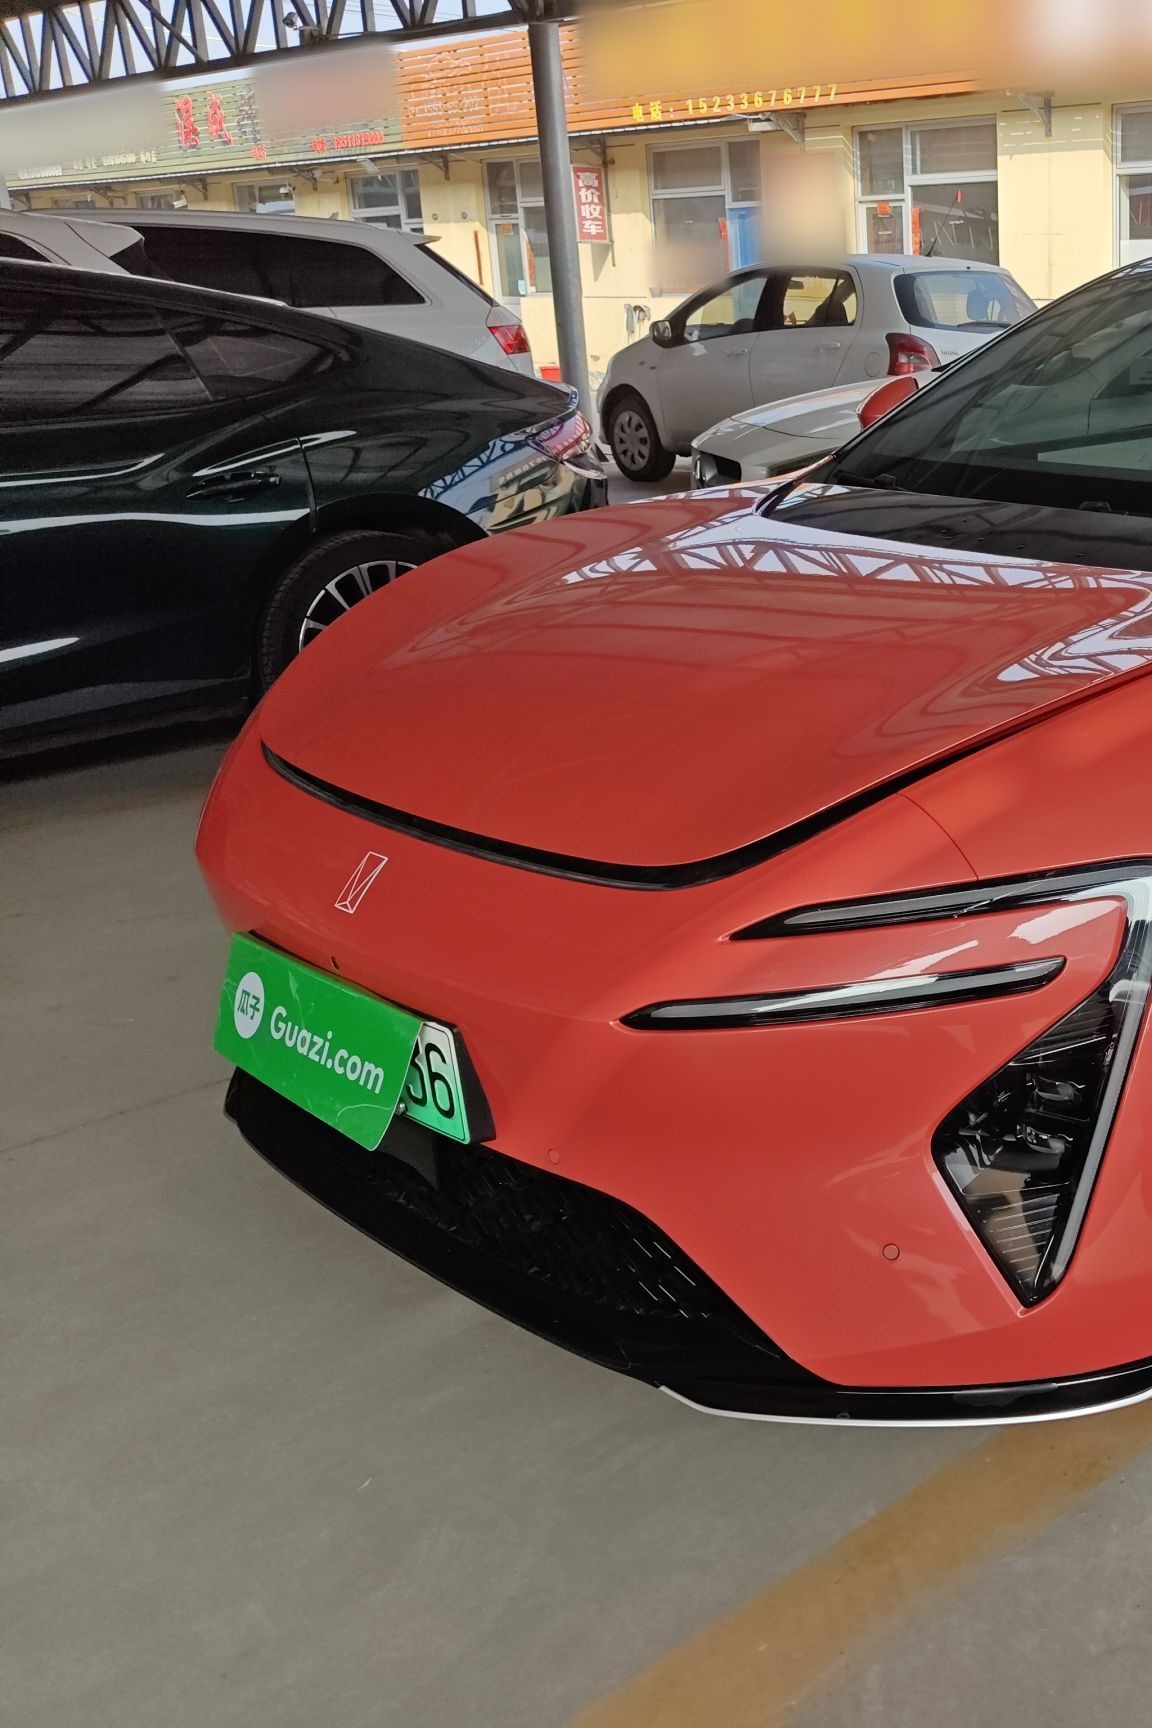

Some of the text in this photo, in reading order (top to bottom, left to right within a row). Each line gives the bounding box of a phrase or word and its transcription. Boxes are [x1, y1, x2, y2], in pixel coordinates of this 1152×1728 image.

[576, 172, 604, 236] 高价收车
[237, 989, 260, 1021] 瓜子
[270, 1005, 384, 1094] Guazi.com
